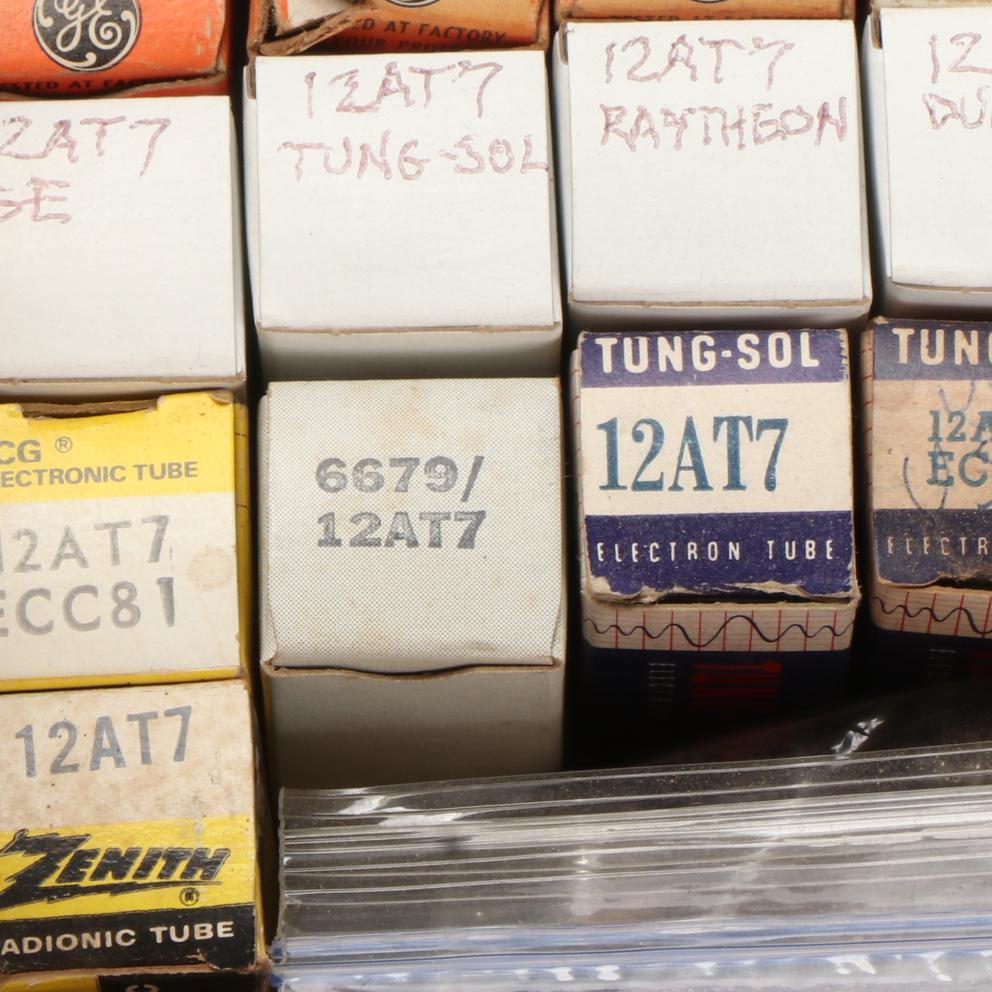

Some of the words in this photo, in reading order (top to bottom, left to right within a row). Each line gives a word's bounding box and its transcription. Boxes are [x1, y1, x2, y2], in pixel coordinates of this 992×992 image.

[418, 24, 507, 44] FACTORY
[604, 34, 795, 89] 12AT7
[305, 61, 502, 117] 12AT7
[600, 97, 848, 152] RAYTHEON
[277, 130, 548, 181] TUNG-SOL
[594, 332, 820, 373] TUNG-SOL
[1, 465, 126, 488] ECTRONIC
[133, 461, 198, 481] TUBE
[597, 415, 789, 492] 12AT7
[316, 456, 485, 502] 6679/
[316, 510, 487, 549] 12AT7
[597, 541, 741, 562] ELECTRON
[767, 540, 834, 560] TUBE
[15, 705, 192, 778] 12AT7
[0, 828, 230, 904] ZENITH
[1, 929, 136, 956] ADIONIC
[150, 921, 234, 944] TUBE
